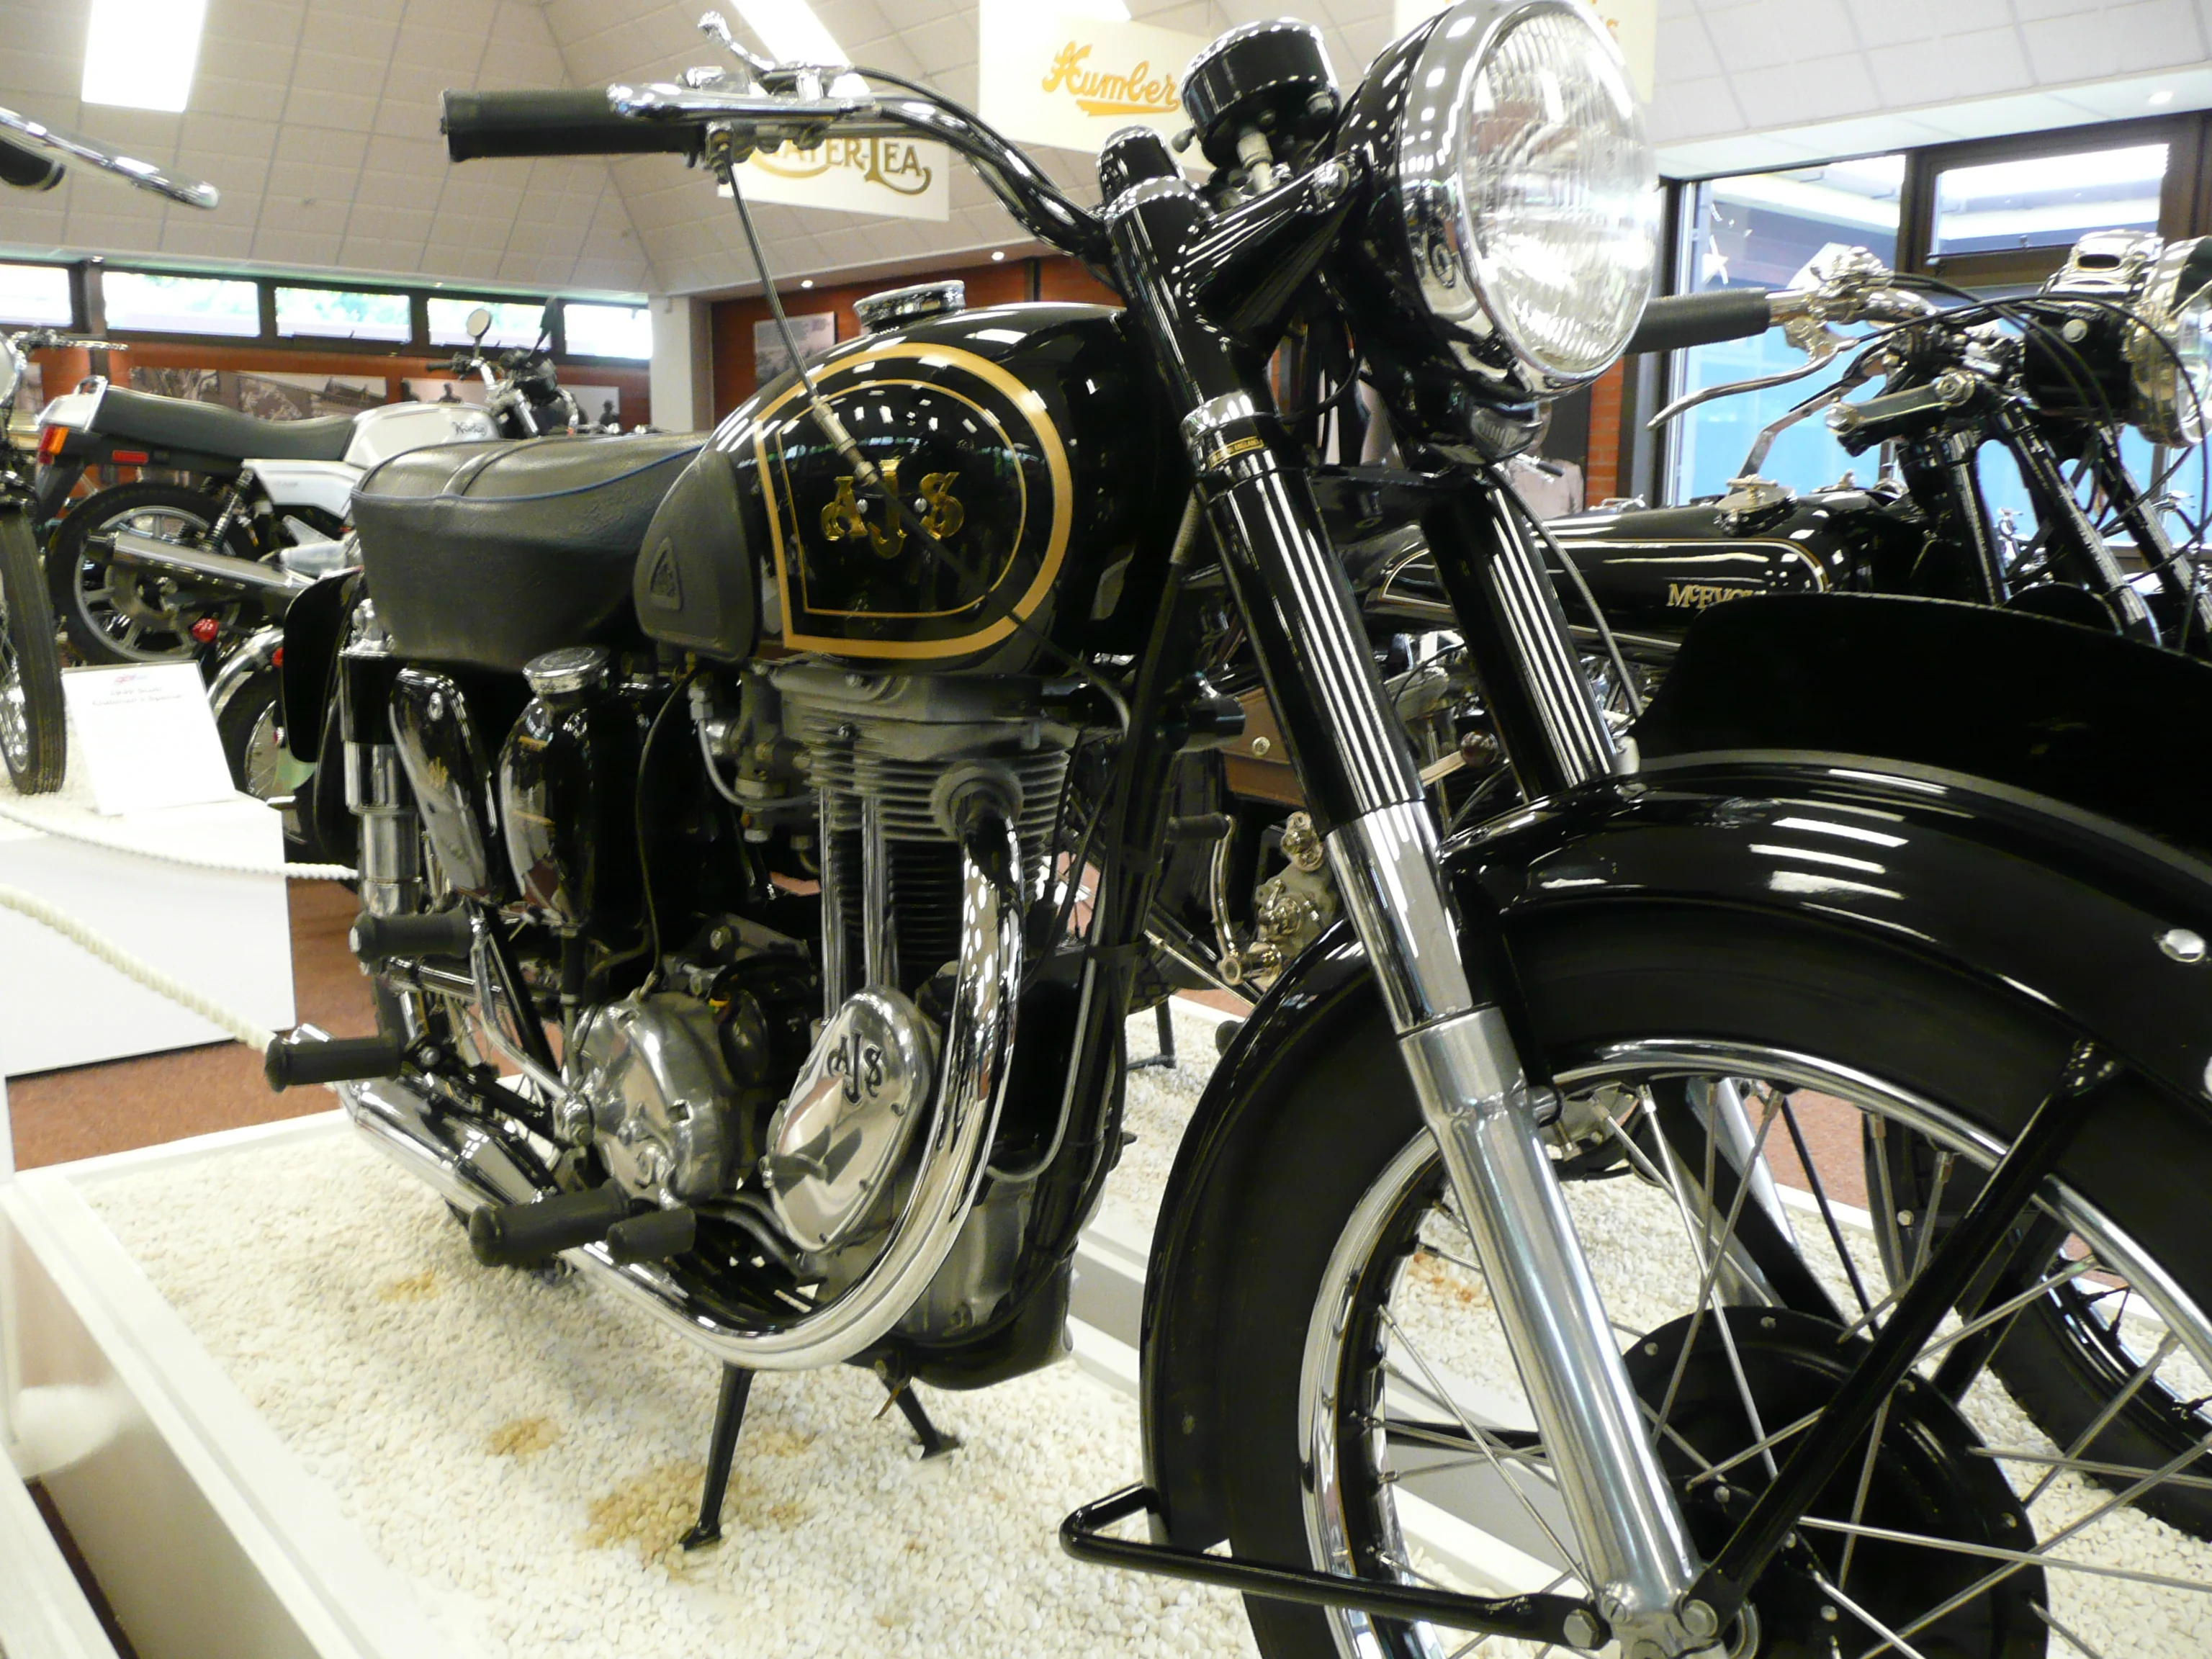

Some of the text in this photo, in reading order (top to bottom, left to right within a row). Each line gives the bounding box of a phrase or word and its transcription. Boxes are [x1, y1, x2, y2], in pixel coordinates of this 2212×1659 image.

[1042, 40, 1181, 116] Humber
[821, 458, 965, 560] AJS
[826, 1030, 884, 1105] AJS
